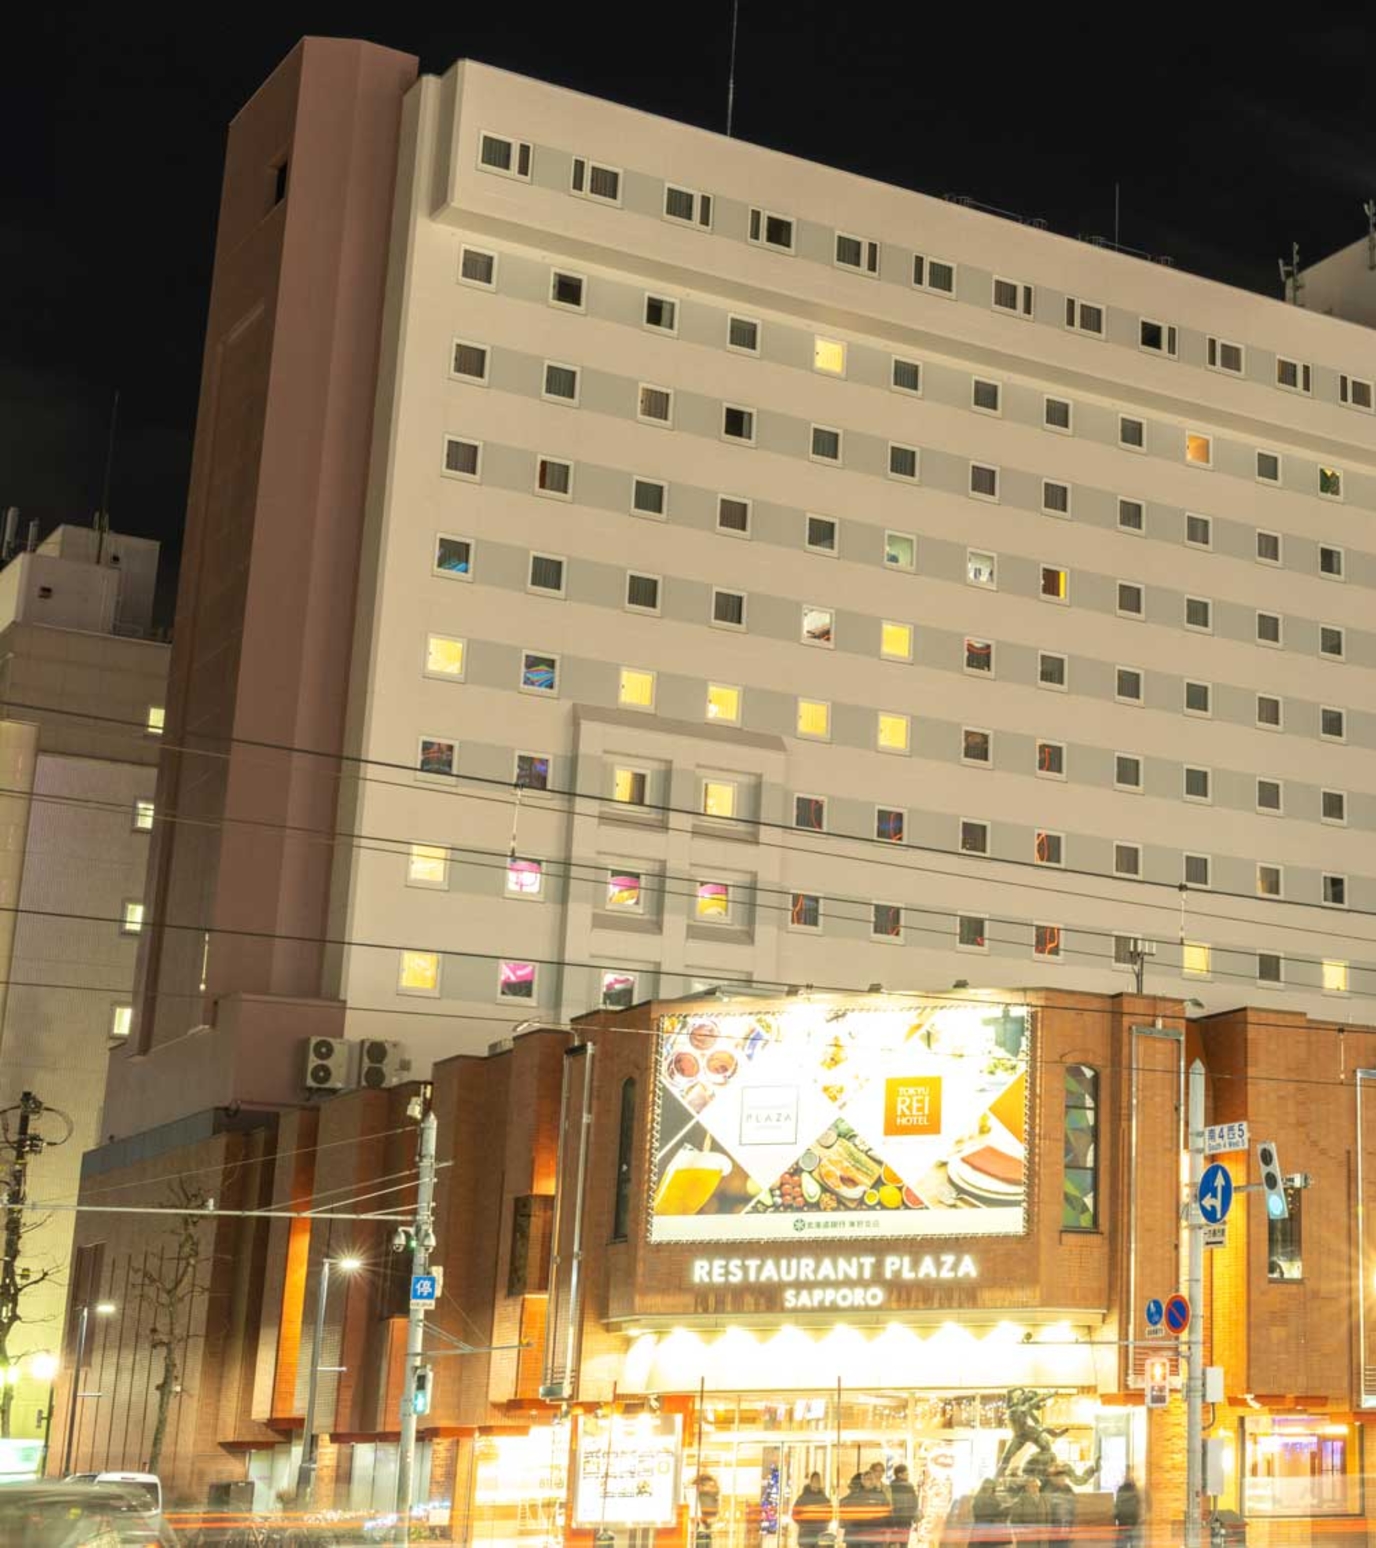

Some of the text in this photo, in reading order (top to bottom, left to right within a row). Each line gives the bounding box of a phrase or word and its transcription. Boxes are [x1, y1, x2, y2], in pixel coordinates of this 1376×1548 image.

[897, 1086, 930, 1097] TOKYU
[896, 1097, 930, 1116] REI
[745, 1112, 793, 1123] PLAZA
[896, 1116, 930, 1126] HOTEL
[693, 1254, 978, 1283] RESTAURANT PLAZA
[784, 1287, 884, 1308] SAPPORO
